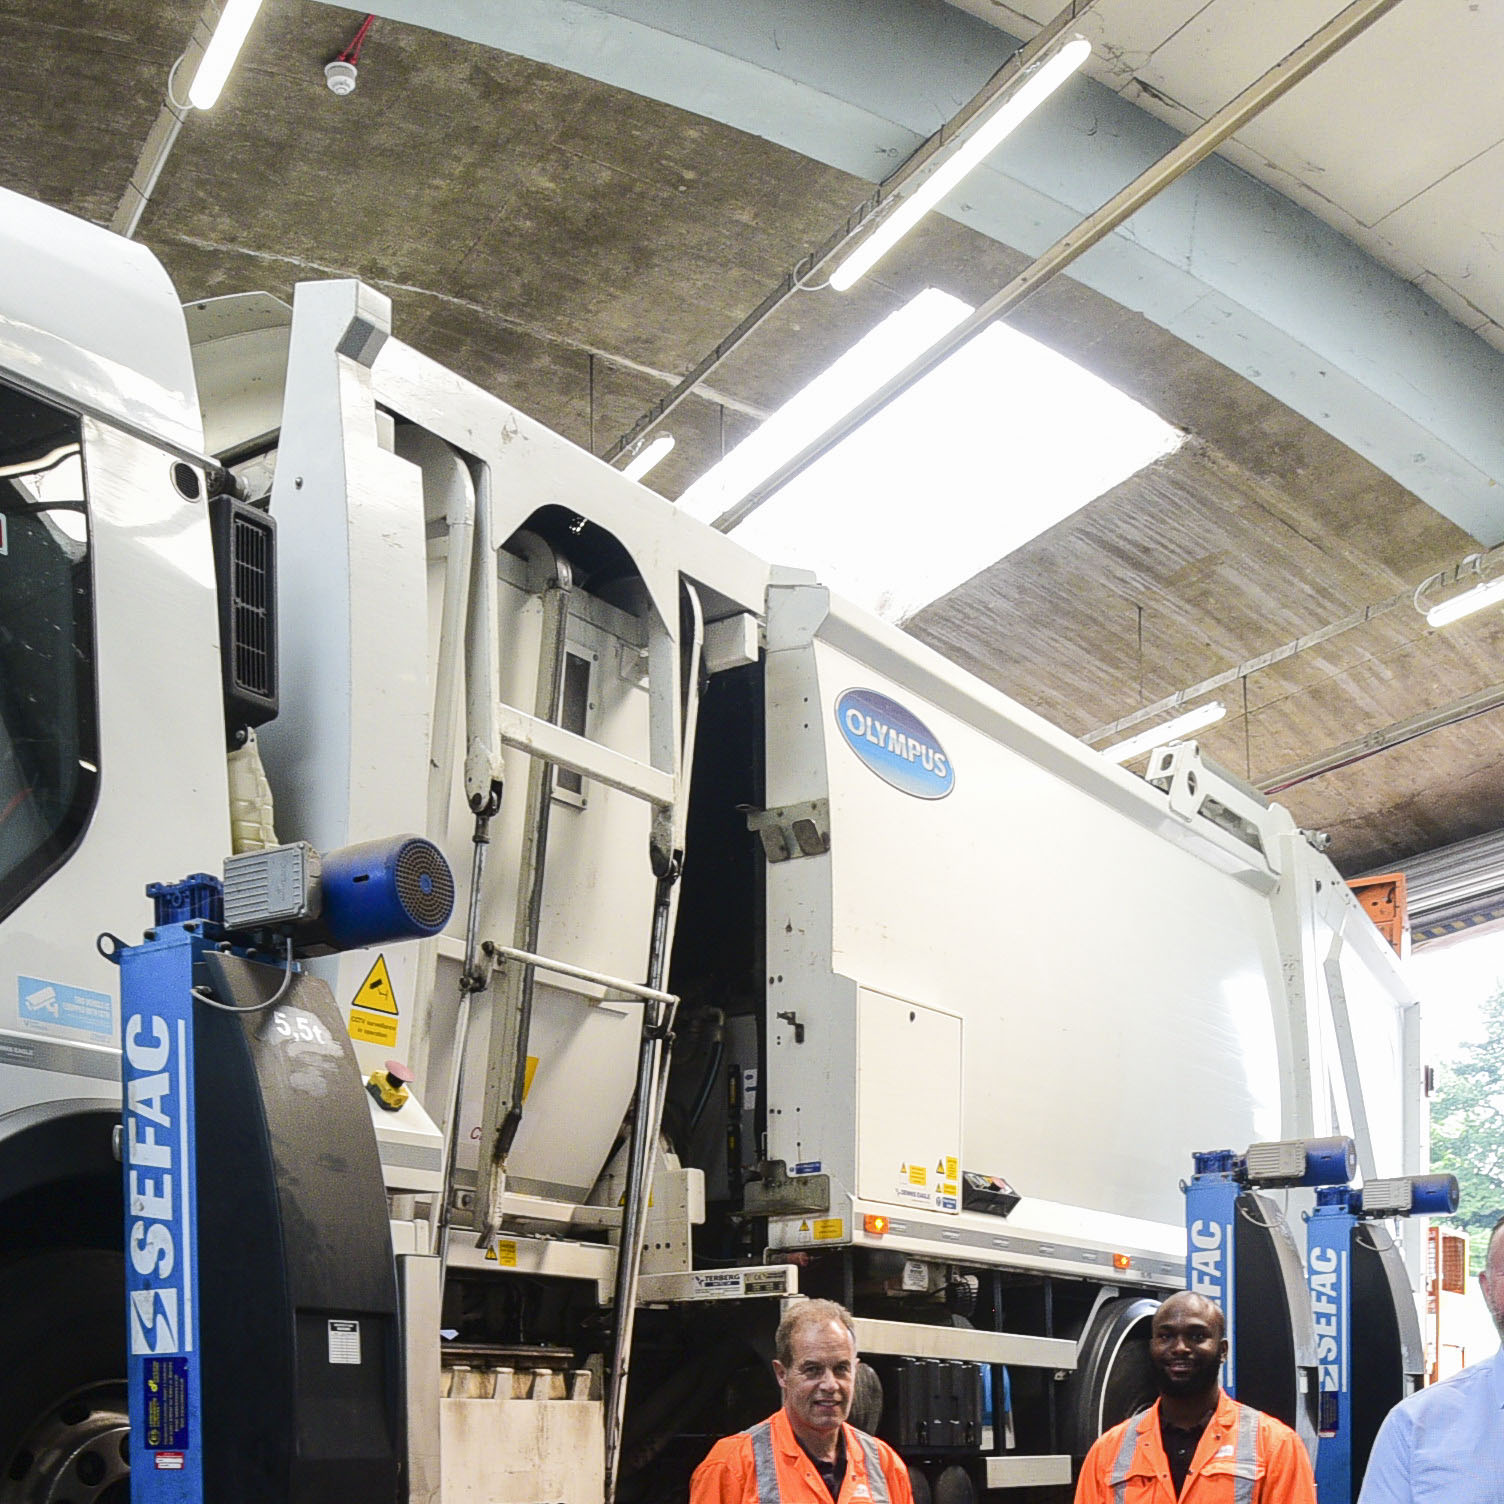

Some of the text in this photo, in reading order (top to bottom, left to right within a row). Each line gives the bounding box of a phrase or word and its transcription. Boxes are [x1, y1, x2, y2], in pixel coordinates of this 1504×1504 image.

[845, 708, 948, 778] OLYMPUS
[273, 1011, 326, 1045] 5,5t
[125, 1013, 175, 1279] SEFAC
[704, 1273, 741, 1282] TERBERG
[1191, 1219, 1223, 1306] FAC
[1310, 1246, 1338, 1362] SEFAC
